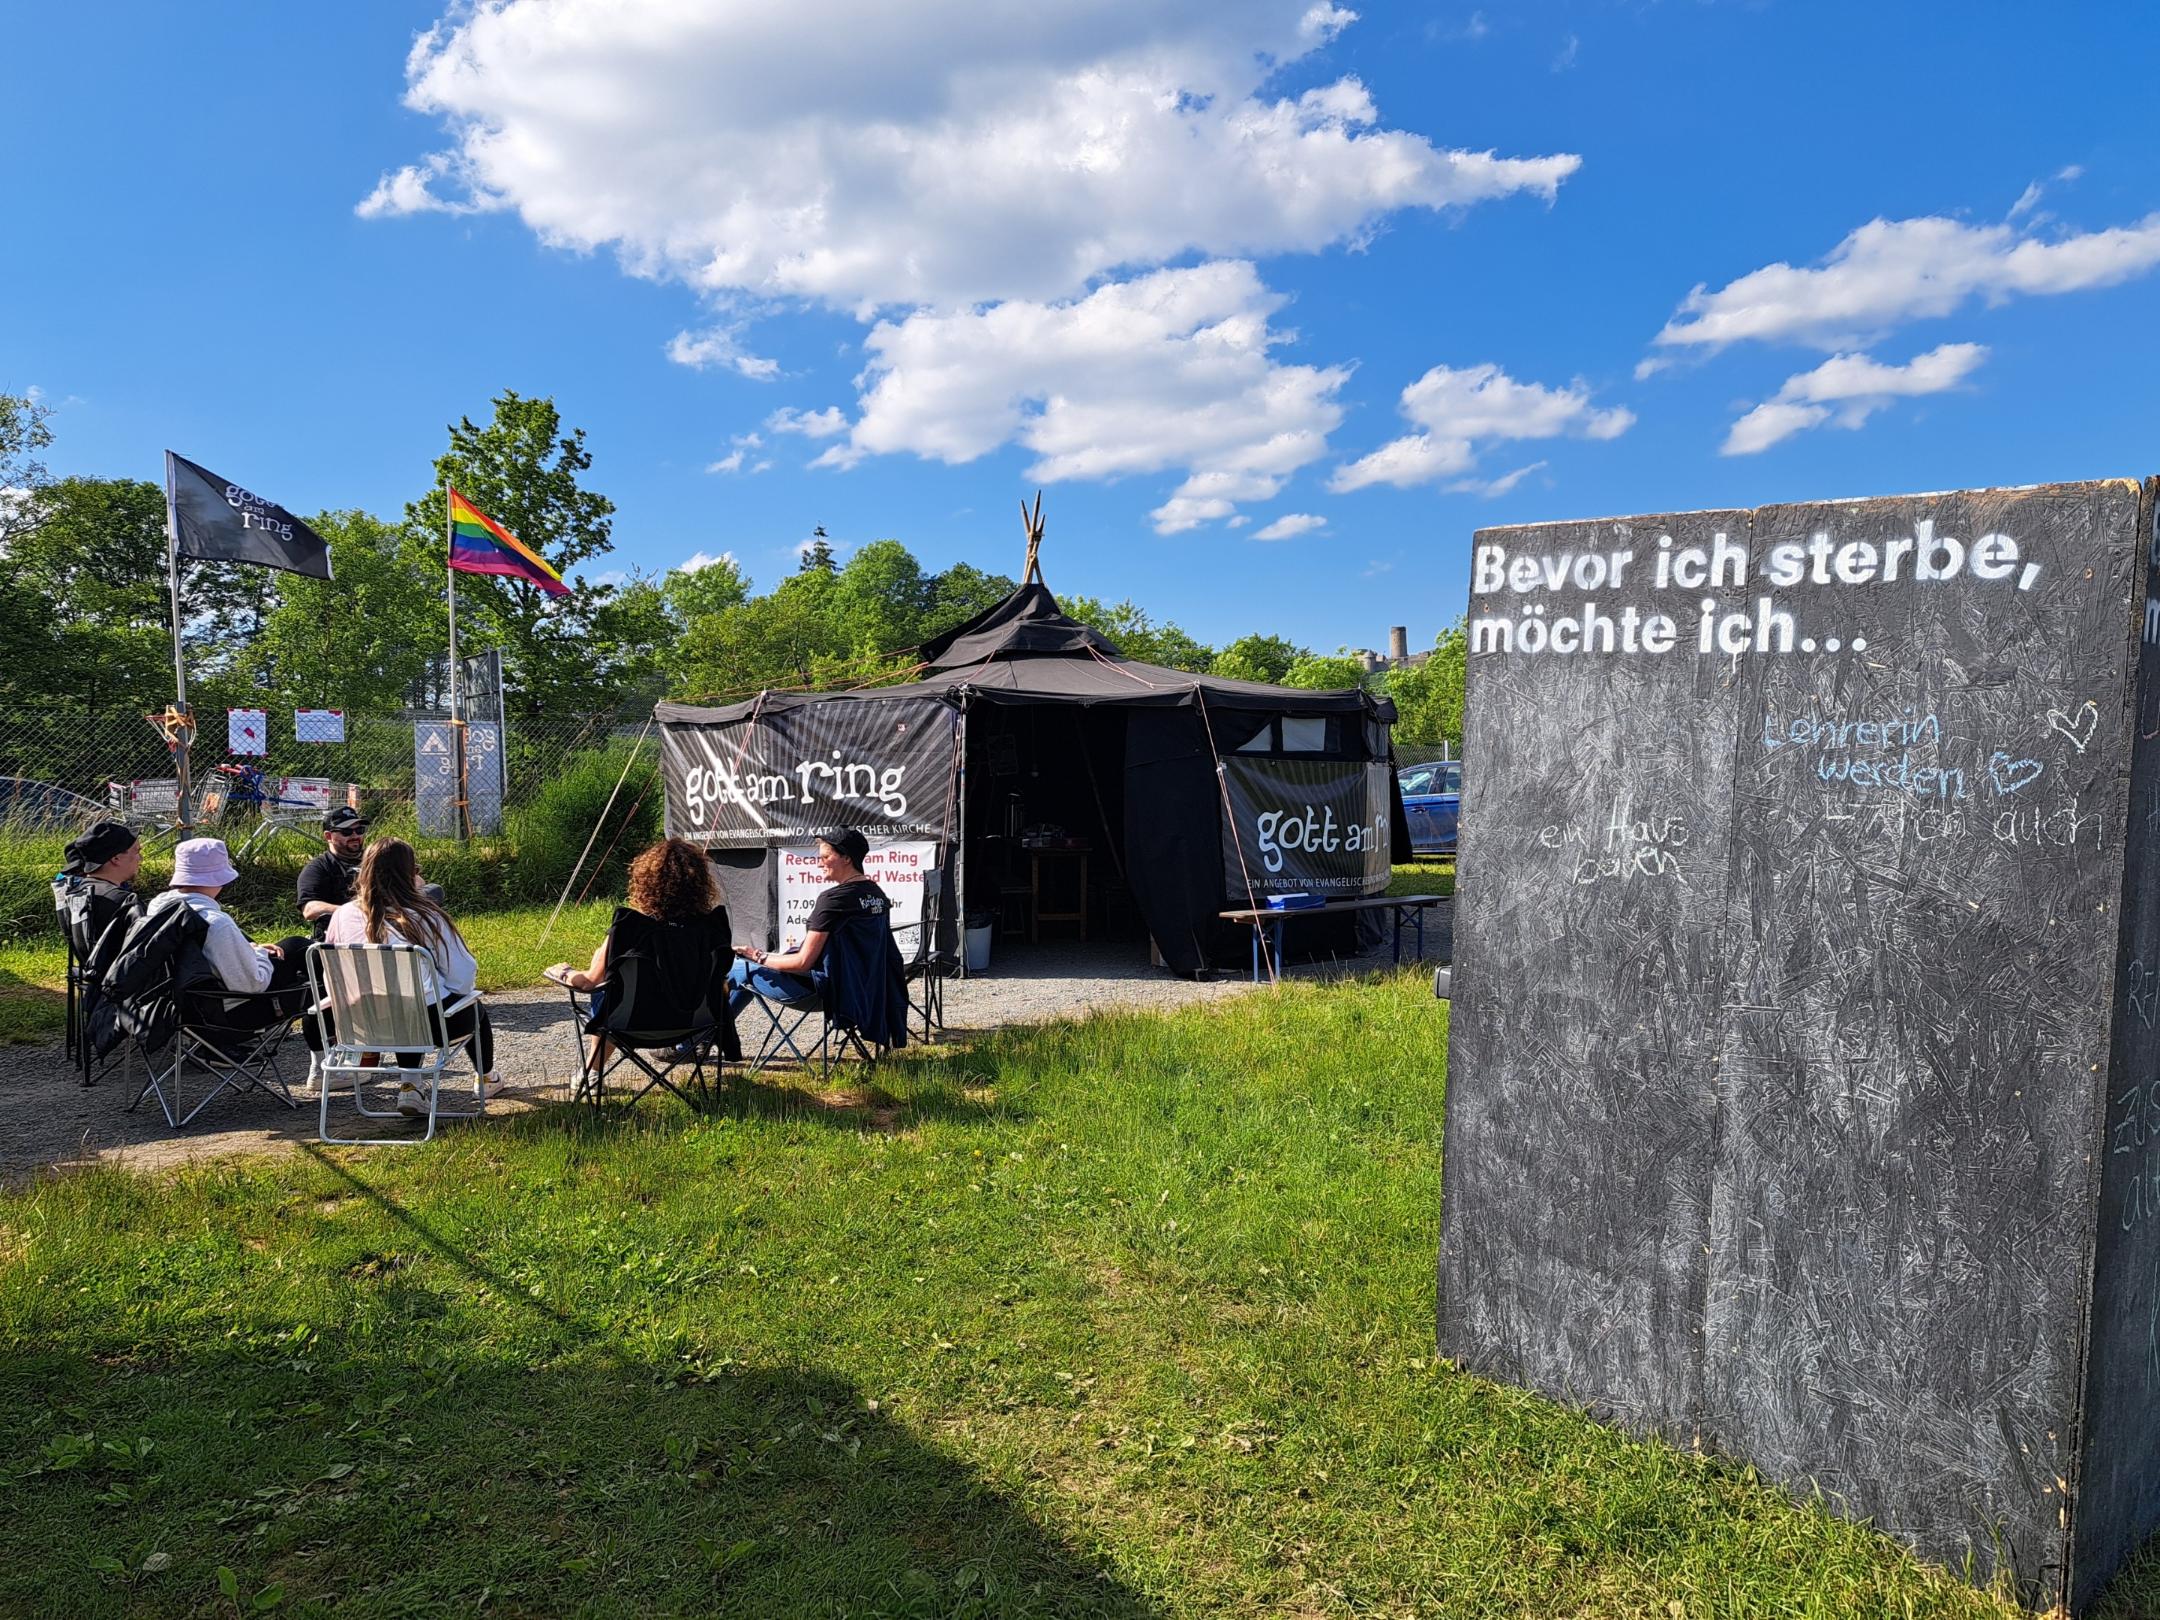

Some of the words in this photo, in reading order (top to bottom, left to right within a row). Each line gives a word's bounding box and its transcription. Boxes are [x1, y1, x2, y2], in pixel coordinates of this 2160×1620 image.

[241, 511, 293, 542] ring
[1474, 544, 1633, 594] Bevor
[1656, 533, 1748, 588] ich
[1770, 518, 2042, 591] sterbe,
[1471, 602, 1677, 654] möchte
[1699, 597, 1868, 656] ich...
[745, 772, 796, 804] am
[795, 750, 907, 817] ring
[1817, 752, 1968, 797] werden
[892, 823, 931, 835] KIRCHE
[1257, 804, 1341, 872] gott
[1344, 823, 1375, 852] am
[864, 854, 884, 864] am
[889, 851, 918, 866] Ring
[885, 871, 925, 883] Waste
[1263, 878, 1298, 889] ANGEBOT
[1300, 878, 1314, 888] VON
[890, 898, 903, 908] hr
